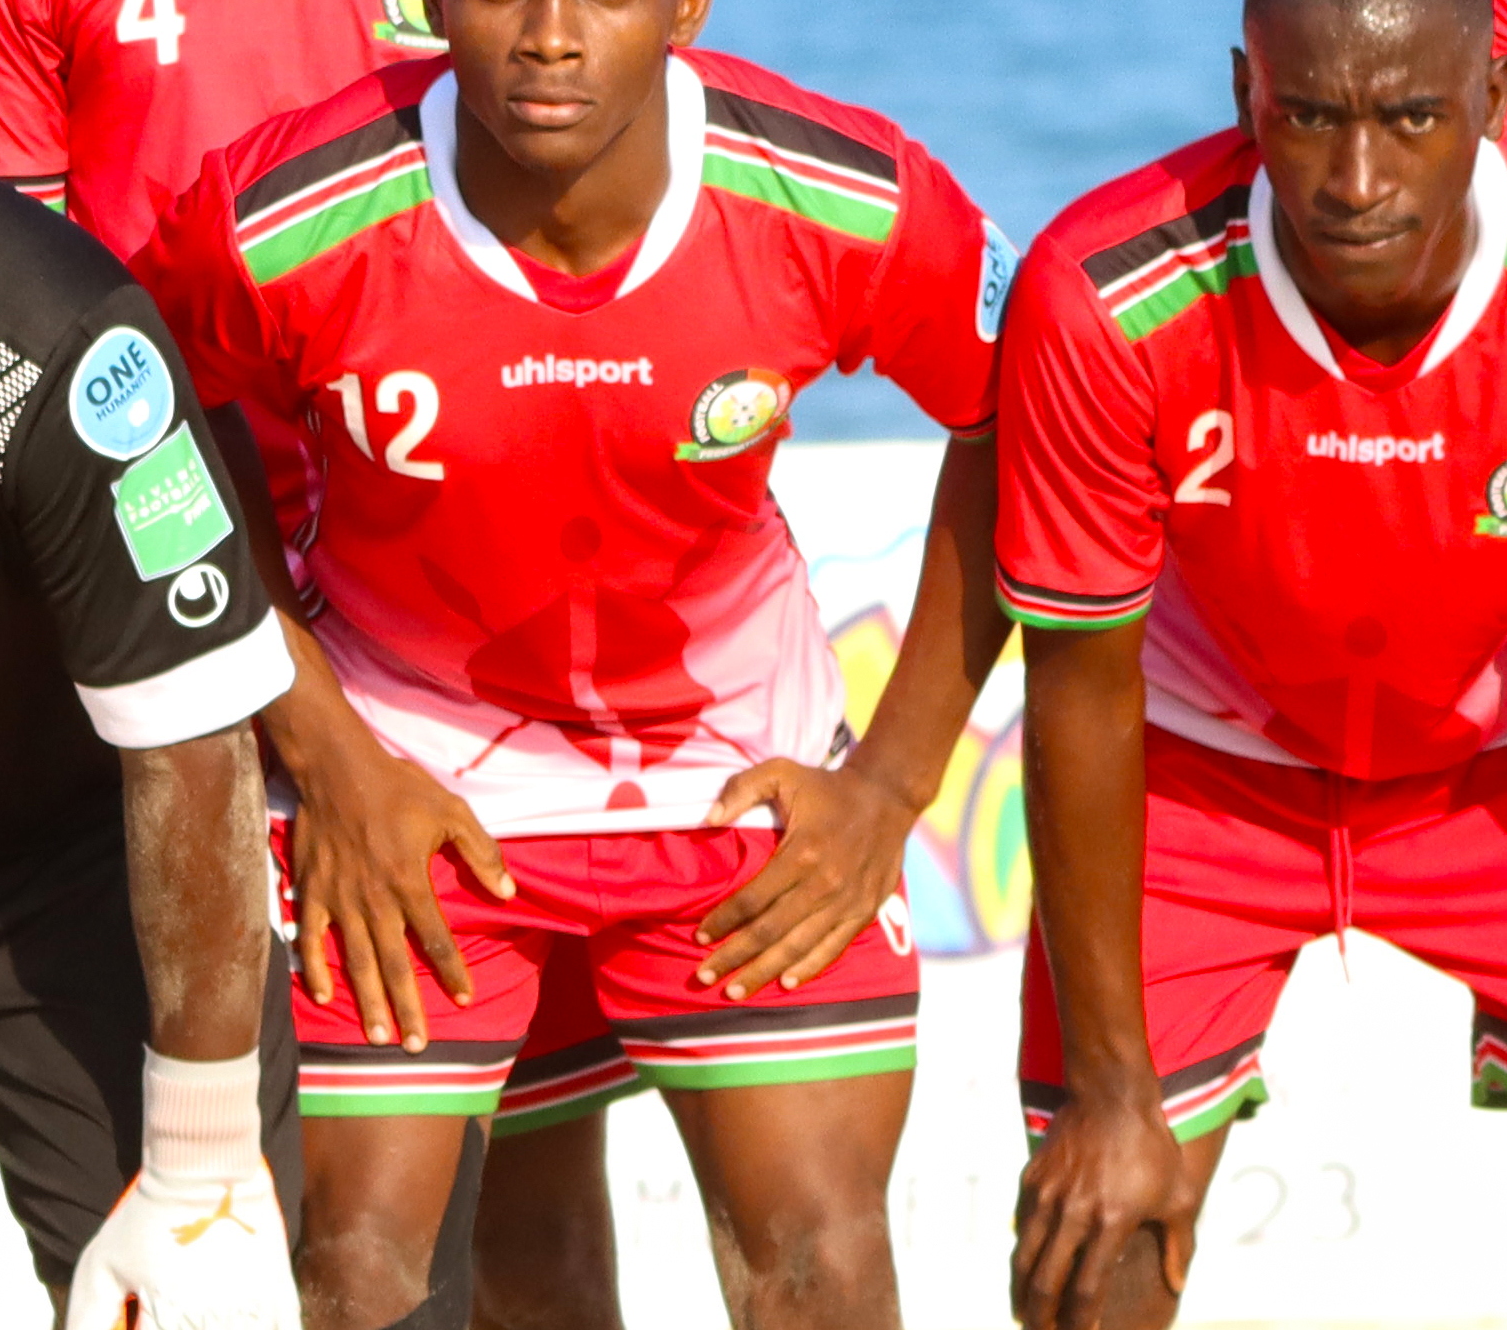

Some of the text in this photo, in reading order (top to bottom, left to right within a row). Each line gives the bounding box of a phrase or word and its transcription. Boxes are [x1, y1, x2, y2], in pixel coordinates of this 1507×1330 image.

[85, 340, 148, 408] ONE
[95, 368, 153, 421] HUMANITY
[501, 353, 653, 388] uhlsport
[326, 370, 445, 481] 12
[1306, 430, 1445, 467] uhlsport
[1173, 409, 1235, 507] 2
